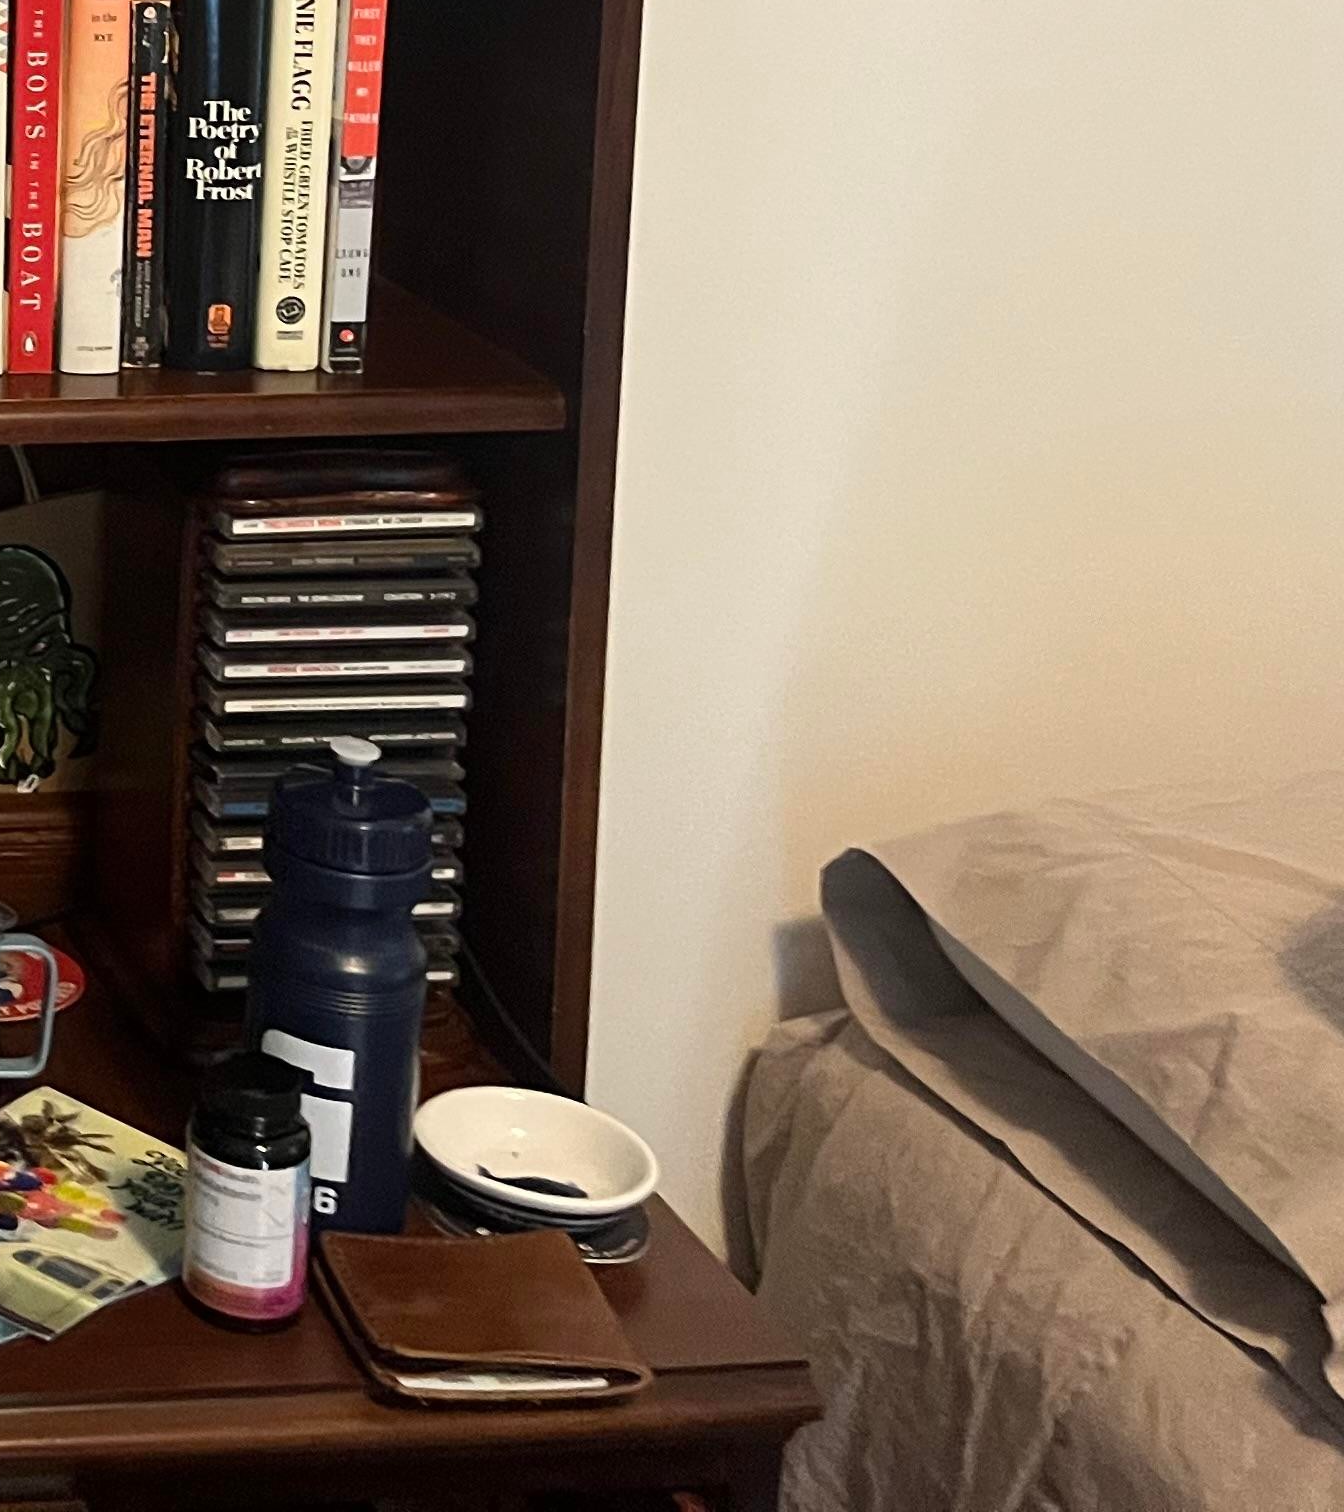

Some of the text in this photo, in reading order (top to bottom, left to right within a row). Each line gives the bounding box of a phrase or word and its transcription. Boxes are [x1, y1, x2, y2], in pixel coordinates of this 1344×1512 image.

[353, 8, 381, 19] FIRST
[291, 40, 314, 111] FLAGG
[348, 61, 381, 72] KILLED
[204, 100, 251, 121] The
[188, 117, 260, 143] Poetry
[214, 140, 238, 160] of
[19, 50, 49, 310] BOYS BOAT
[186, 158, 262, 183] Robert
[195, 180, 253, 200] Frost
[293, 215, 309, 290] TOMATOES
[336, 249, 369, 258] LOUNG
